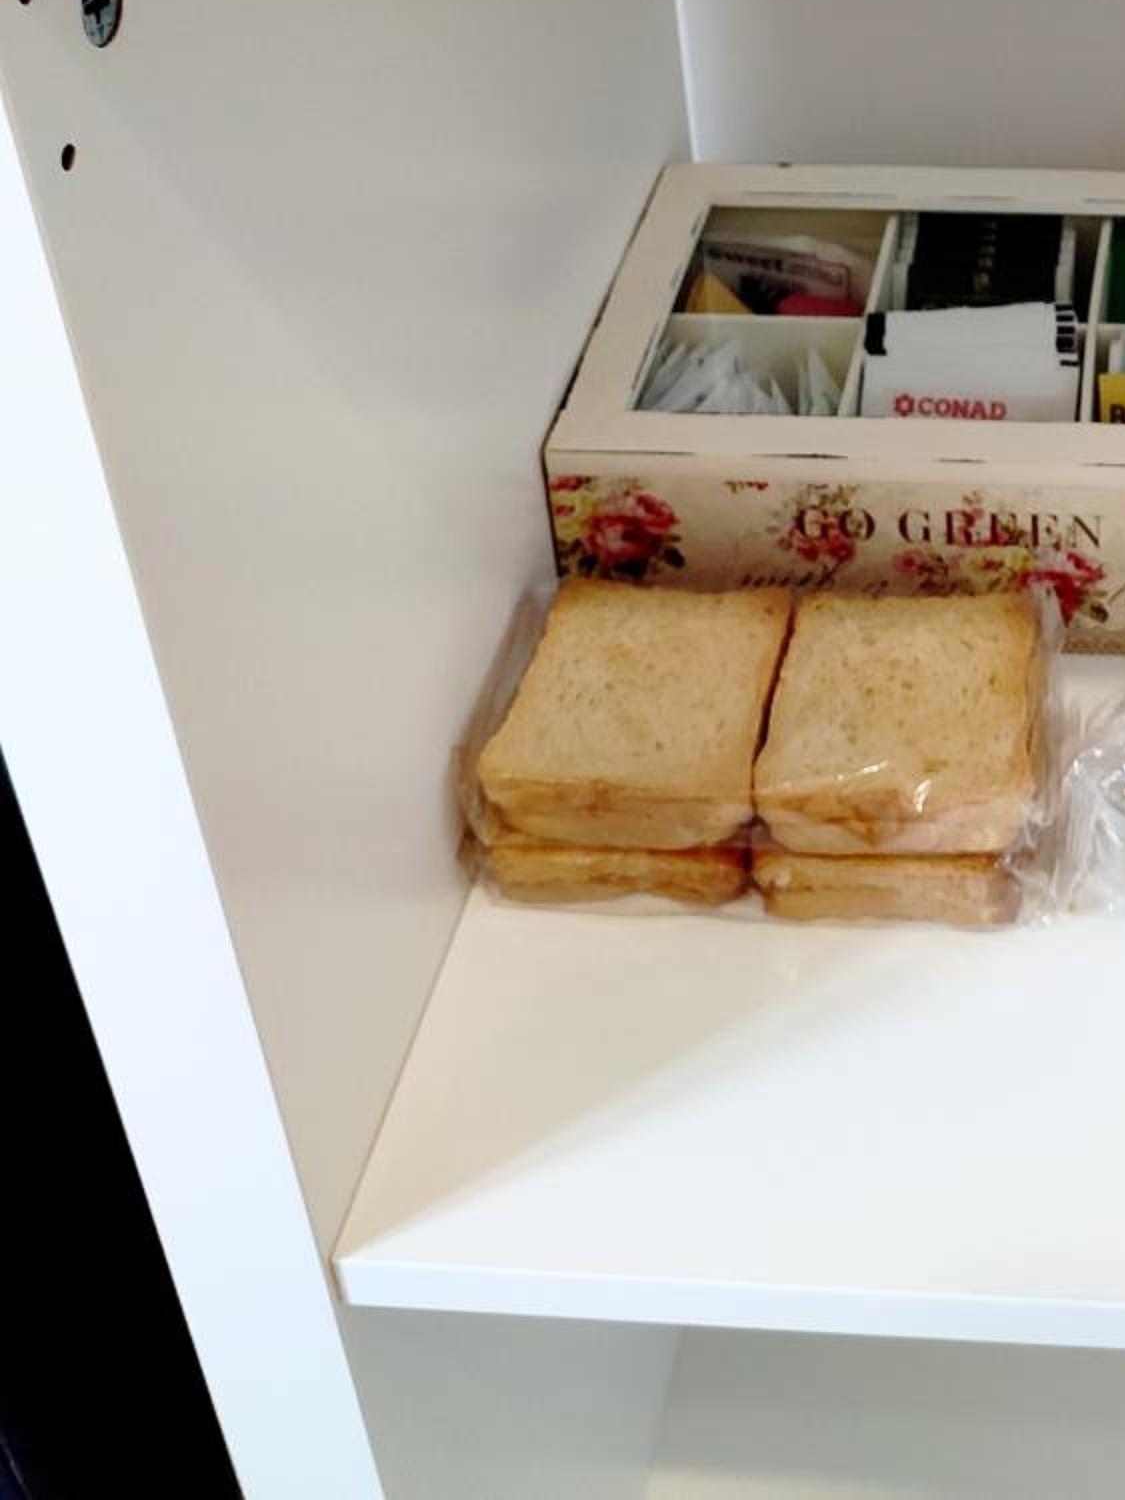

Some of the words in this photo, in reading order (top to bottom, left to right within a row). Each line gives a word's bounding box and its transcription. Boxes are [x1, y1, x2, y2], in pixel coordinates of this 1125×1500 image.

[918, 396, 1007, 421] CONAD
[798, 504, 876, 543] GO
[897, 508, 1102, 550] GREEN
